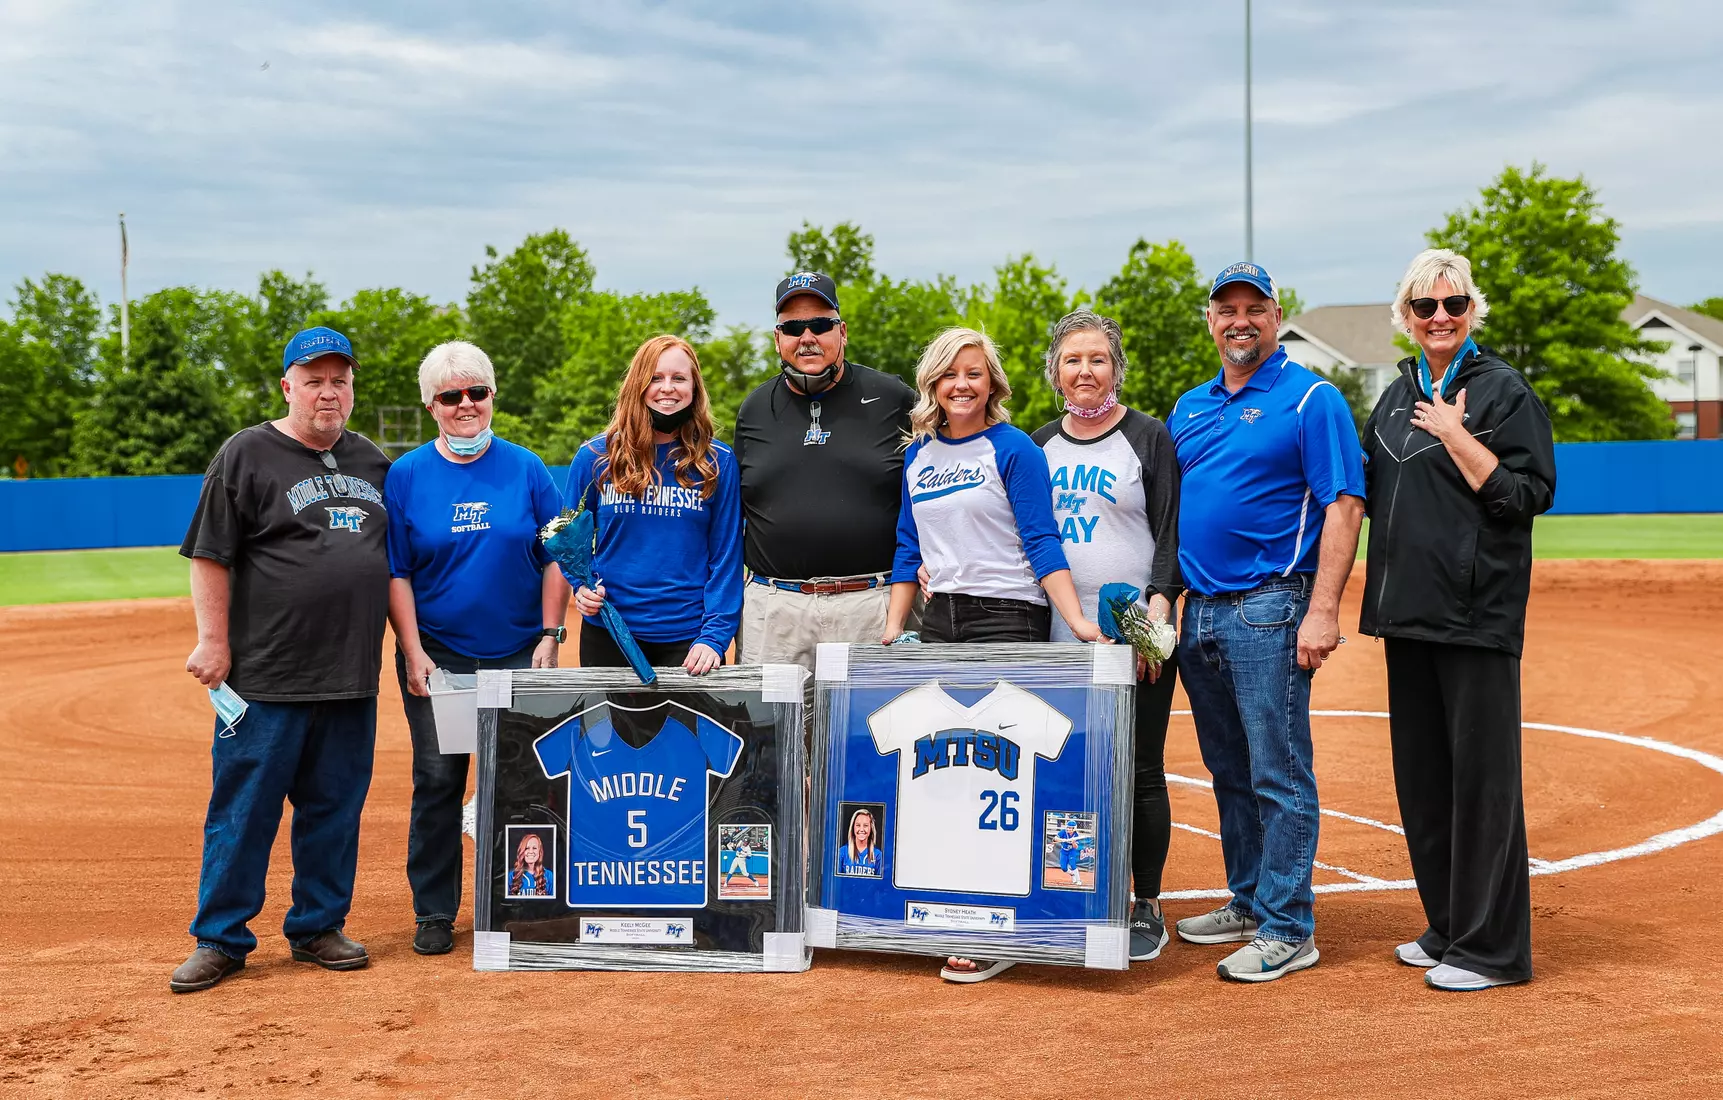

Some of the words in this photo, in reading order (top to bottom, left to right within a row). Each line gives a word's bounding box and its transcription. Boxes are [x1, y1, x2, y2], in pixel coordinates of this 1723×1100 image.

[788, 274, 815, 288] MT
[911, 463, 981, 493] Raiders
[287, 475, 330, 515] MIDDLE
[1054, 492, 1087, 515] MT
[329, 508, 362, 533] MT
[453, 504, 486, 524] MT
[614, 505, 635, 514] BLUE
[641, 506, 681, 517] RAIDERS
[451, 522, 491, 533] SOFTBALL
[912, 728, 1021, 781] MTSU
[589, 772, 687, 803] MIDDLE
[978, 790, 1020, 831] 26
[627, 810, 648, 848] 5
[574, 860, 704, 886] TENNESSEE
